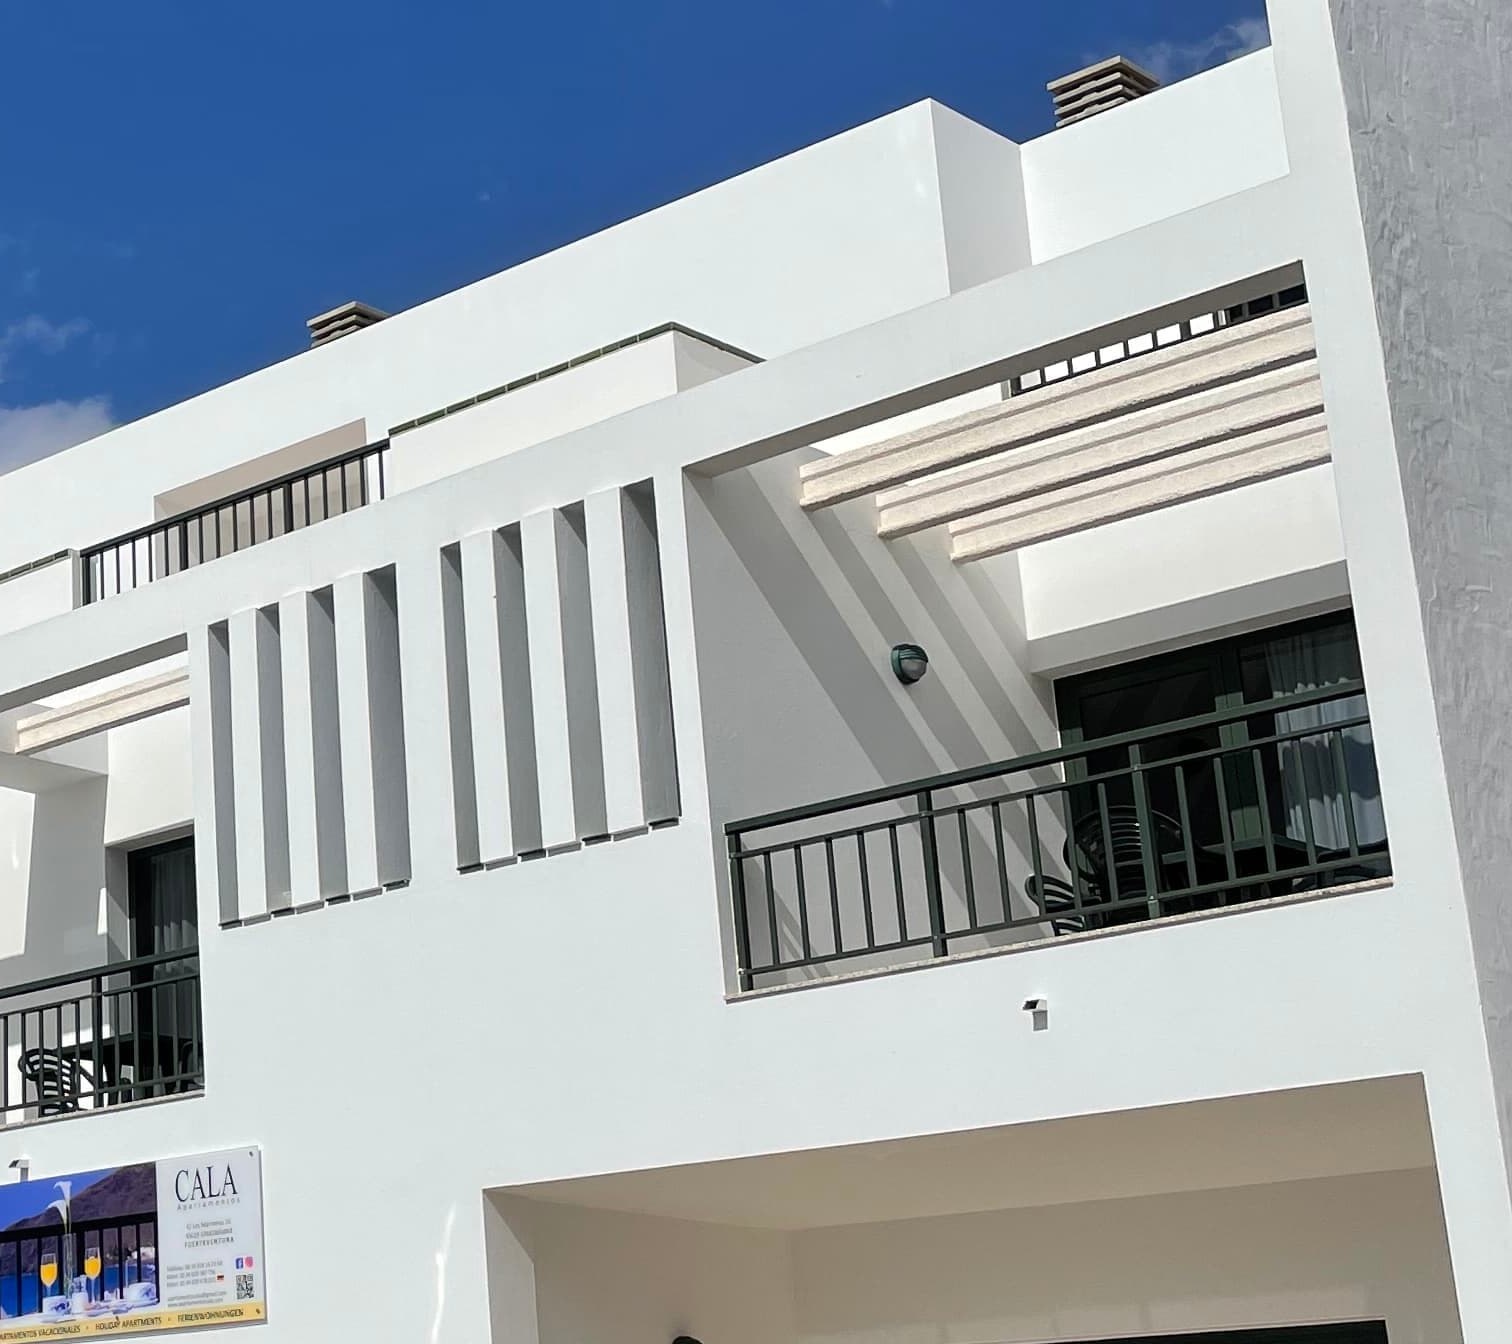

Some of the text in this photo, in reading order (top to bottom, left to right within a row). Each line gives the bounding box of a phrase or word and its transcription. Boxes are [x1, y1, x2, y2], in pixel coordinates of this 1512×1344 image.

[175, 1161, 238, 1202] CALA
[177, 1197, 240, 1211] Apartamentos
[122, 1316, 162, 1327] APARTMENTS
